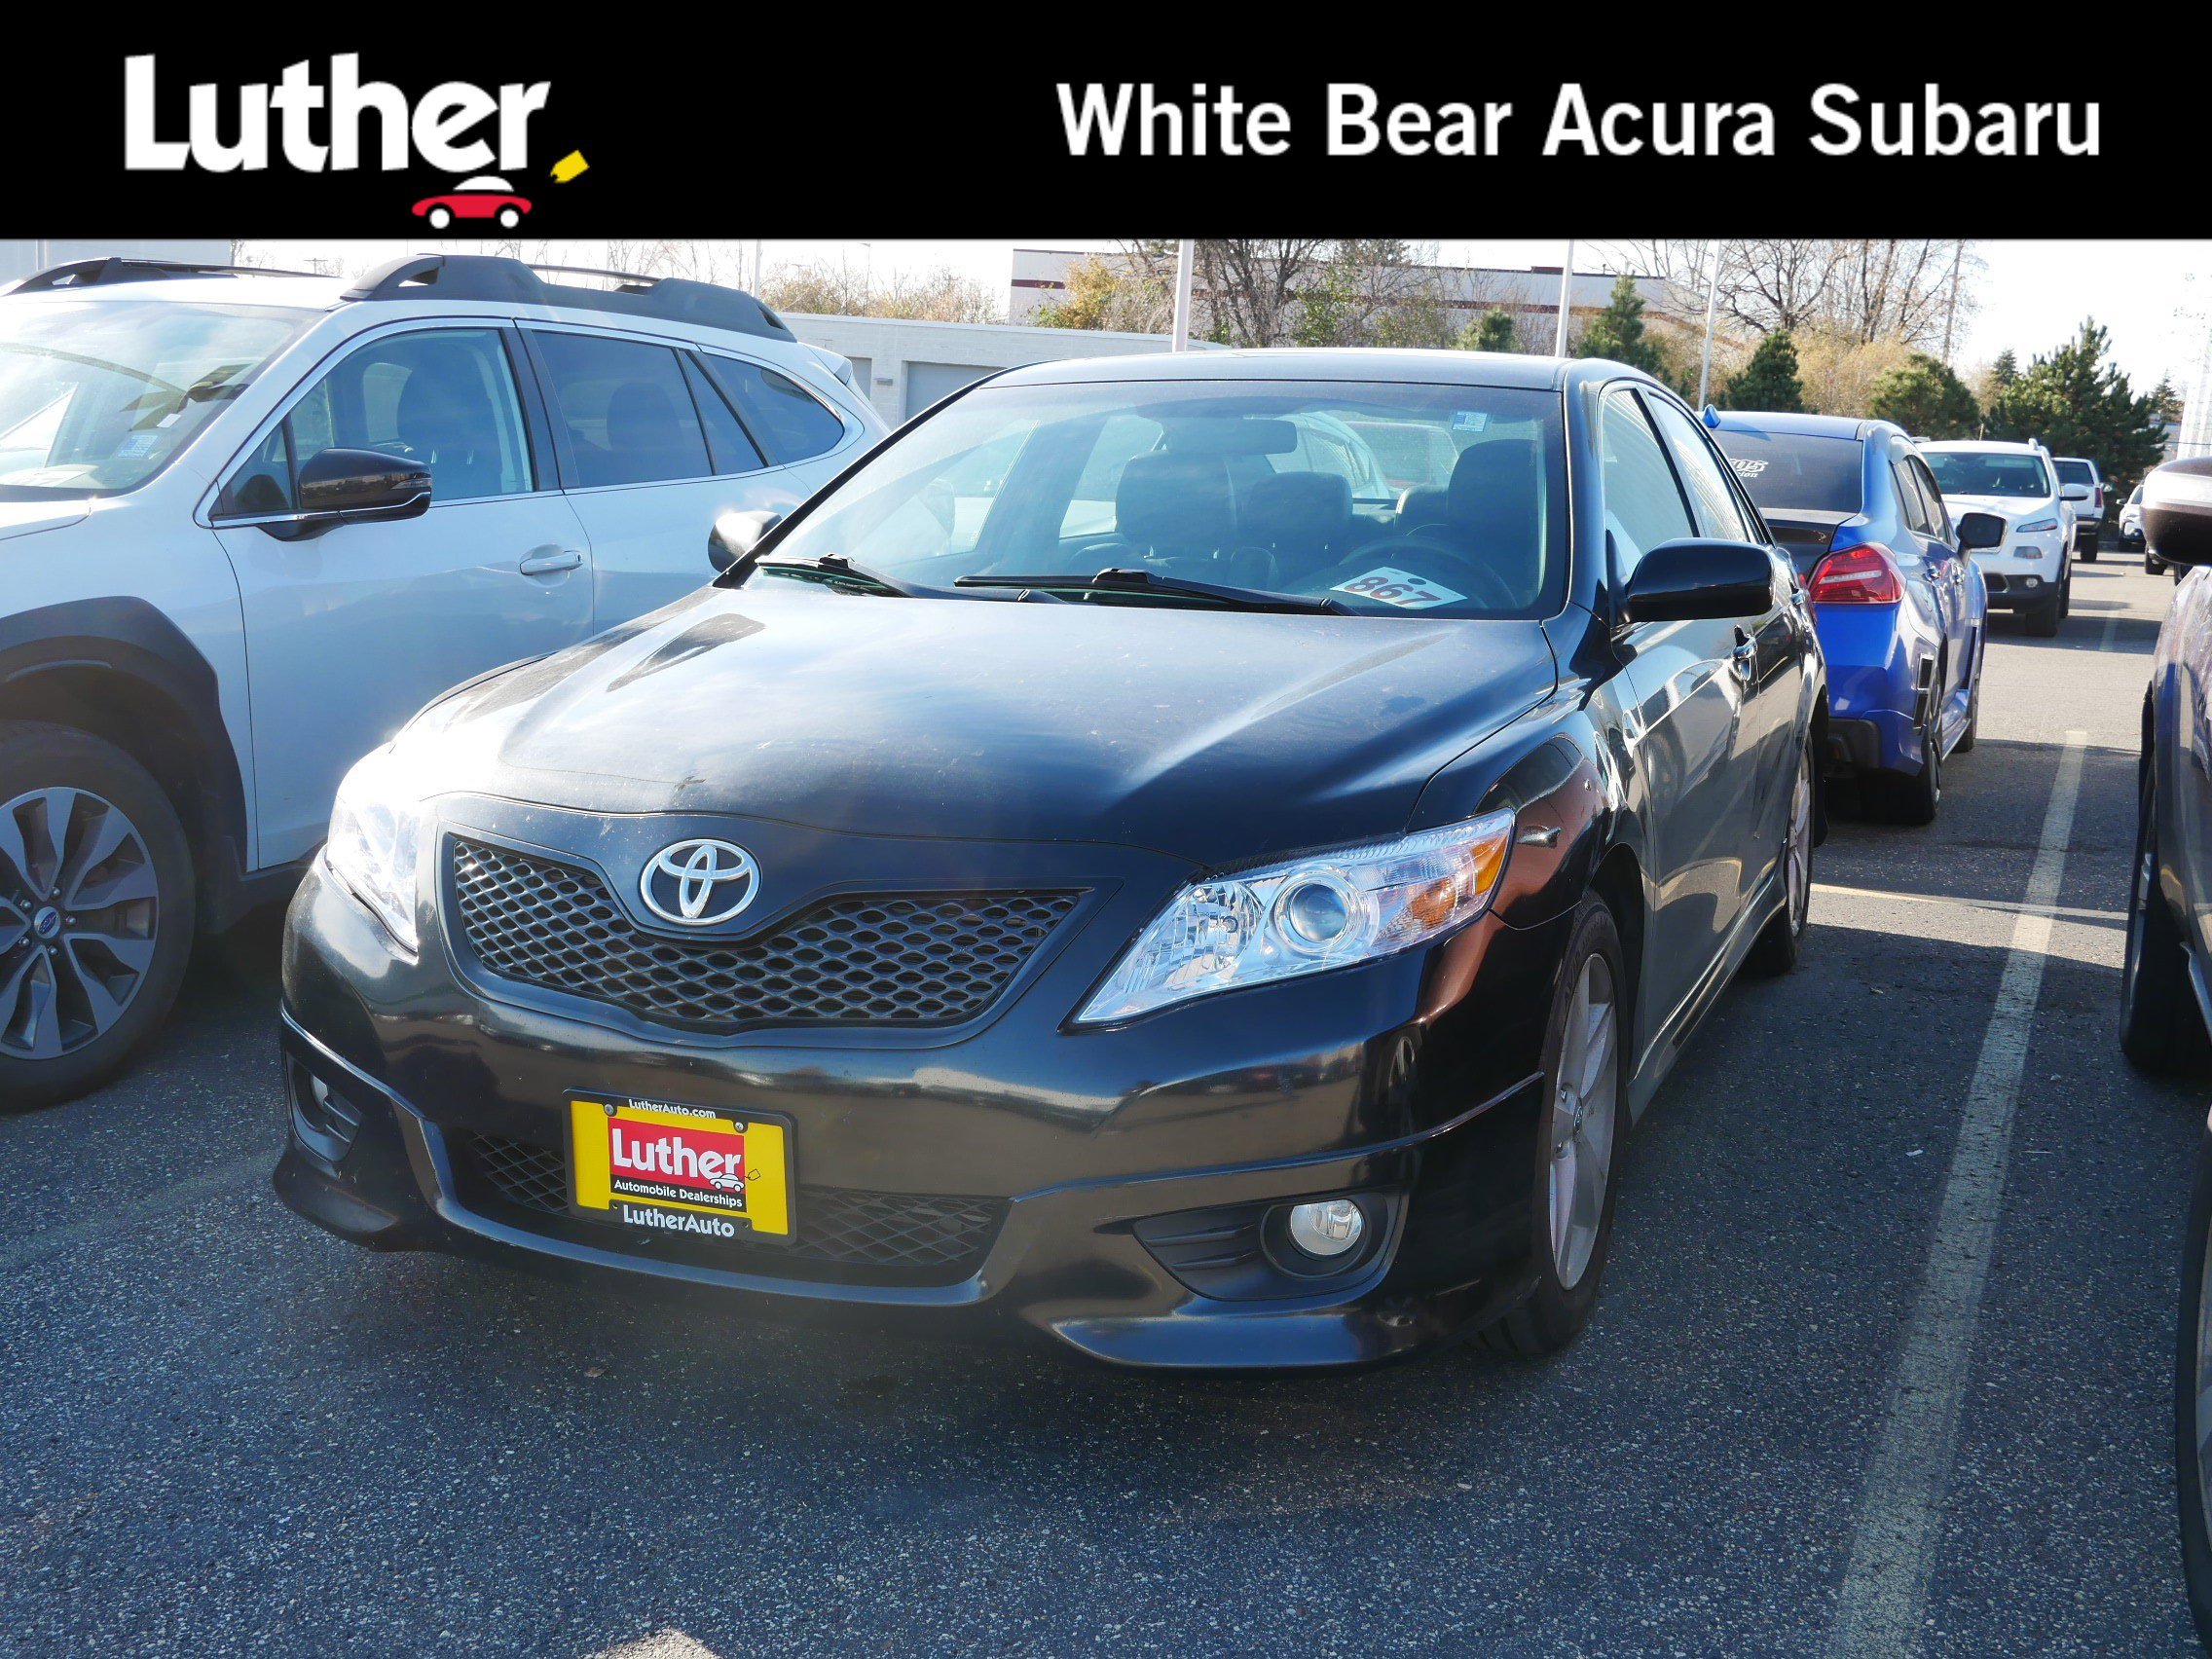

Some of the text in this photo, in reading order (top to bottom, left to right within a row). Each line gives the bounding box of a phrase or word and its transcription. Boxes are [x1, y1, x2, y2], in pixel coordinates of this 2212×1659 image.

[1344, 576, 1443, 606] 867
[628, 1098, 717, 1119] LutherAuto.com
[611, 1127, 742, 1180] Luther
[613, 1179, 743, 1208] Automobile Dealerships
[623, 1204, 735, 1237] LutherAuto
